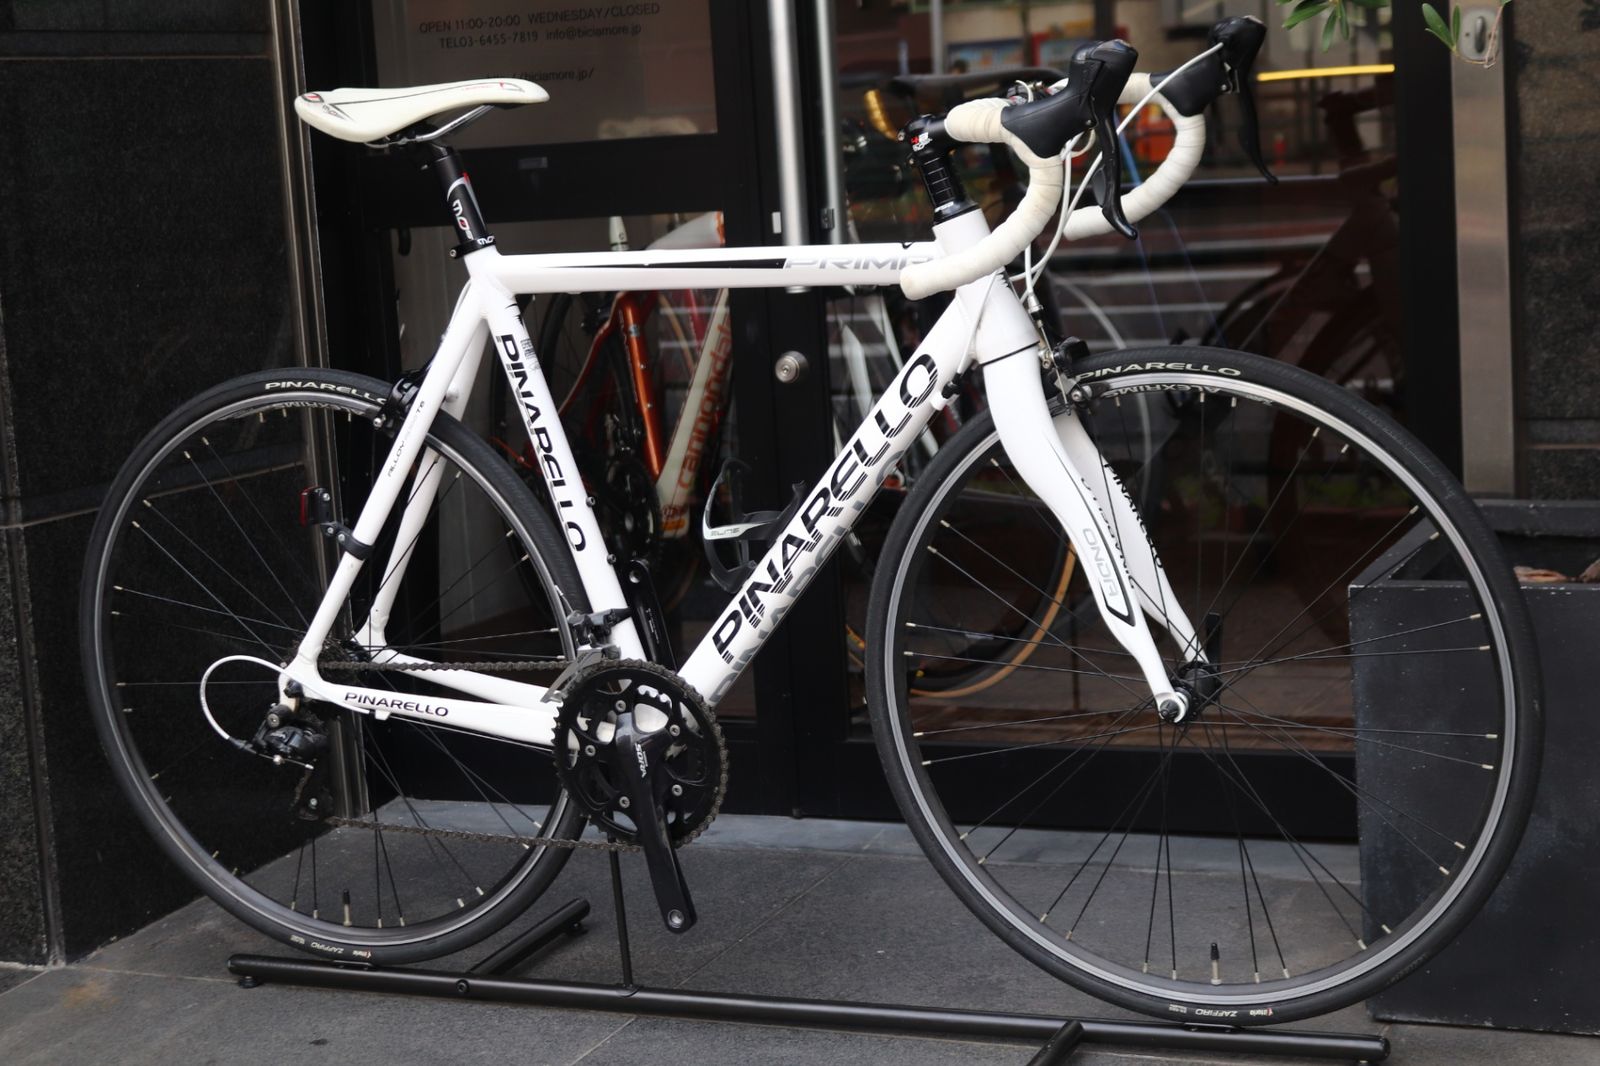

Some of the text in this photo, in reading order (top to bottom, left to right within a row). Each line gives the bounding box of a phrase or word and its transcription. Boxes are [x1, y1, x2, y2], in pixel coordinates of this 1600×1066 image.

[419, 3, 661, 34] OPEN 11:00-20:00 WEDNESDAY/CLOSED
[440, 30, 538, 49] TEL03-6455-7819
[1075, 361, 1242, 380] PINARELLO
[497, 333, 586, 552] PINARELLO
[712, 353, 939, 665] PINARELLO
[344, 692, 449, 717] PINARELLO
[634, 742, 647, 778] SORA
[1195, 1008, 1239, 1018] ZAFFIRO
